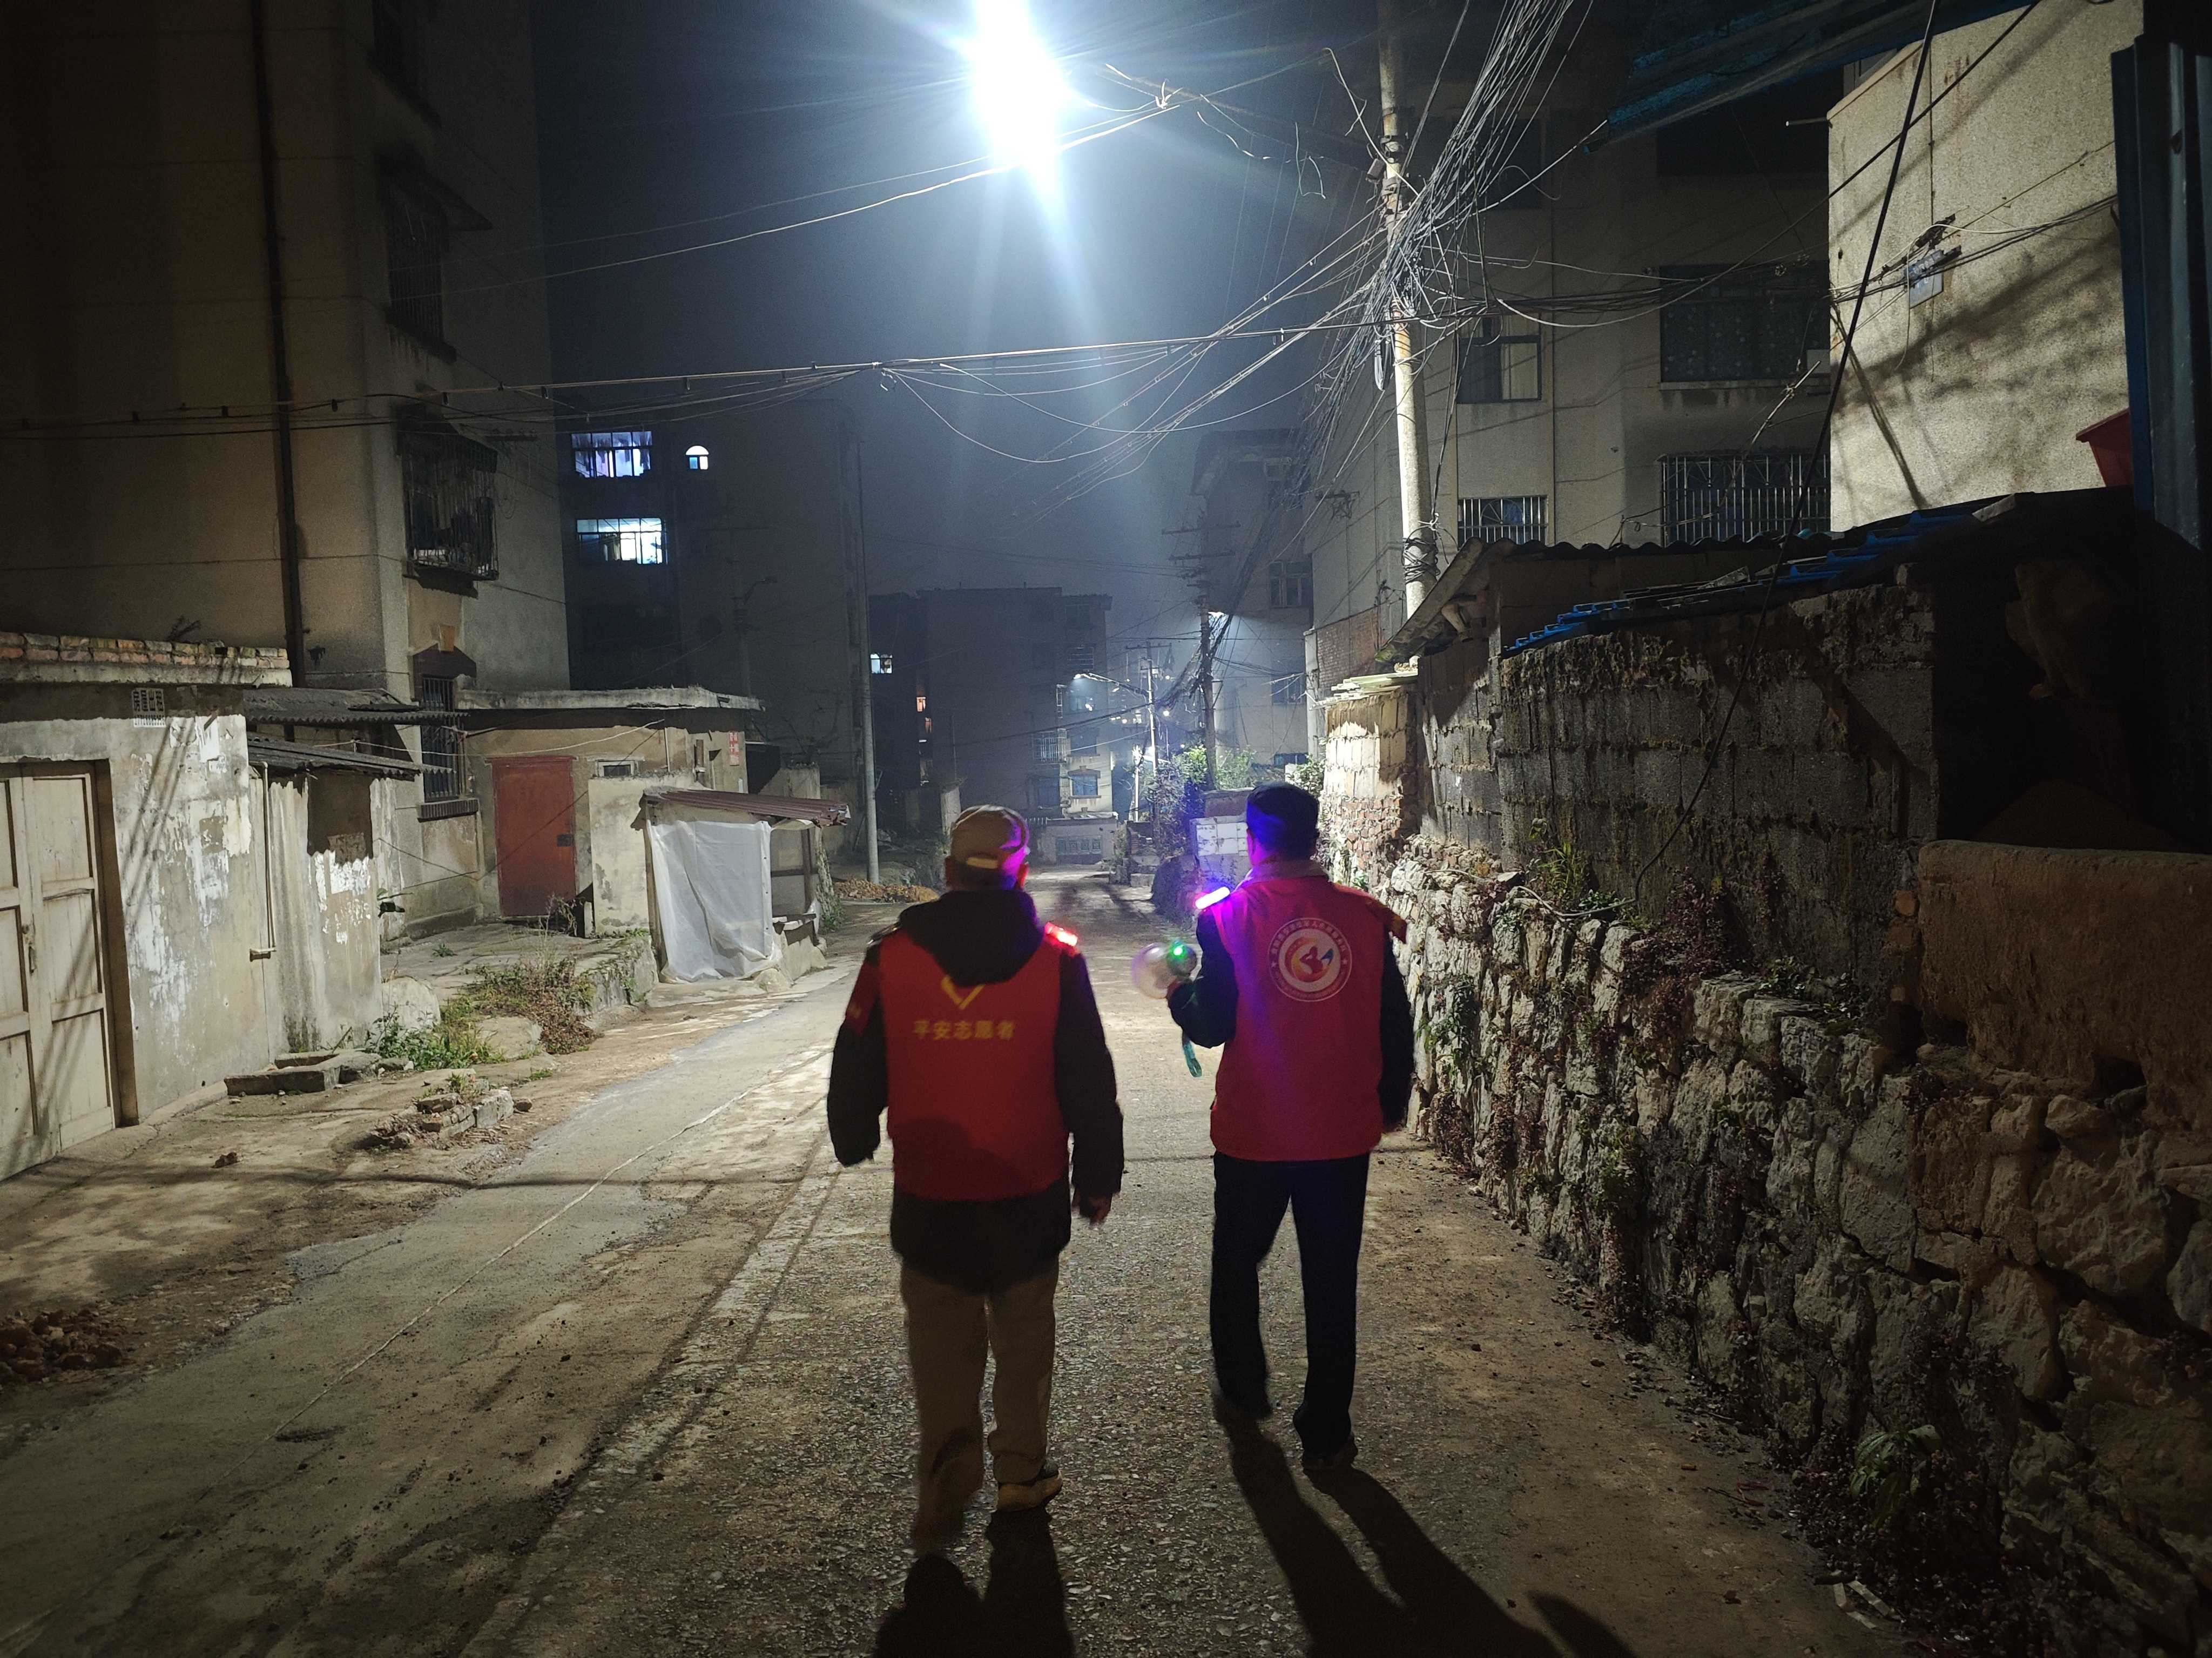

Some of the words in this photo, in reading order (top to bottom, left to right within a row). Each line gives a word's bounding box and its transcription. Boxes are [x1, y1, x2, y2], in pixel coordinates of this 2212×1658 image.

[133, 690, 164, 711] 房屋出租
[912, 1020, 1014, 1040] 平安志愿者
